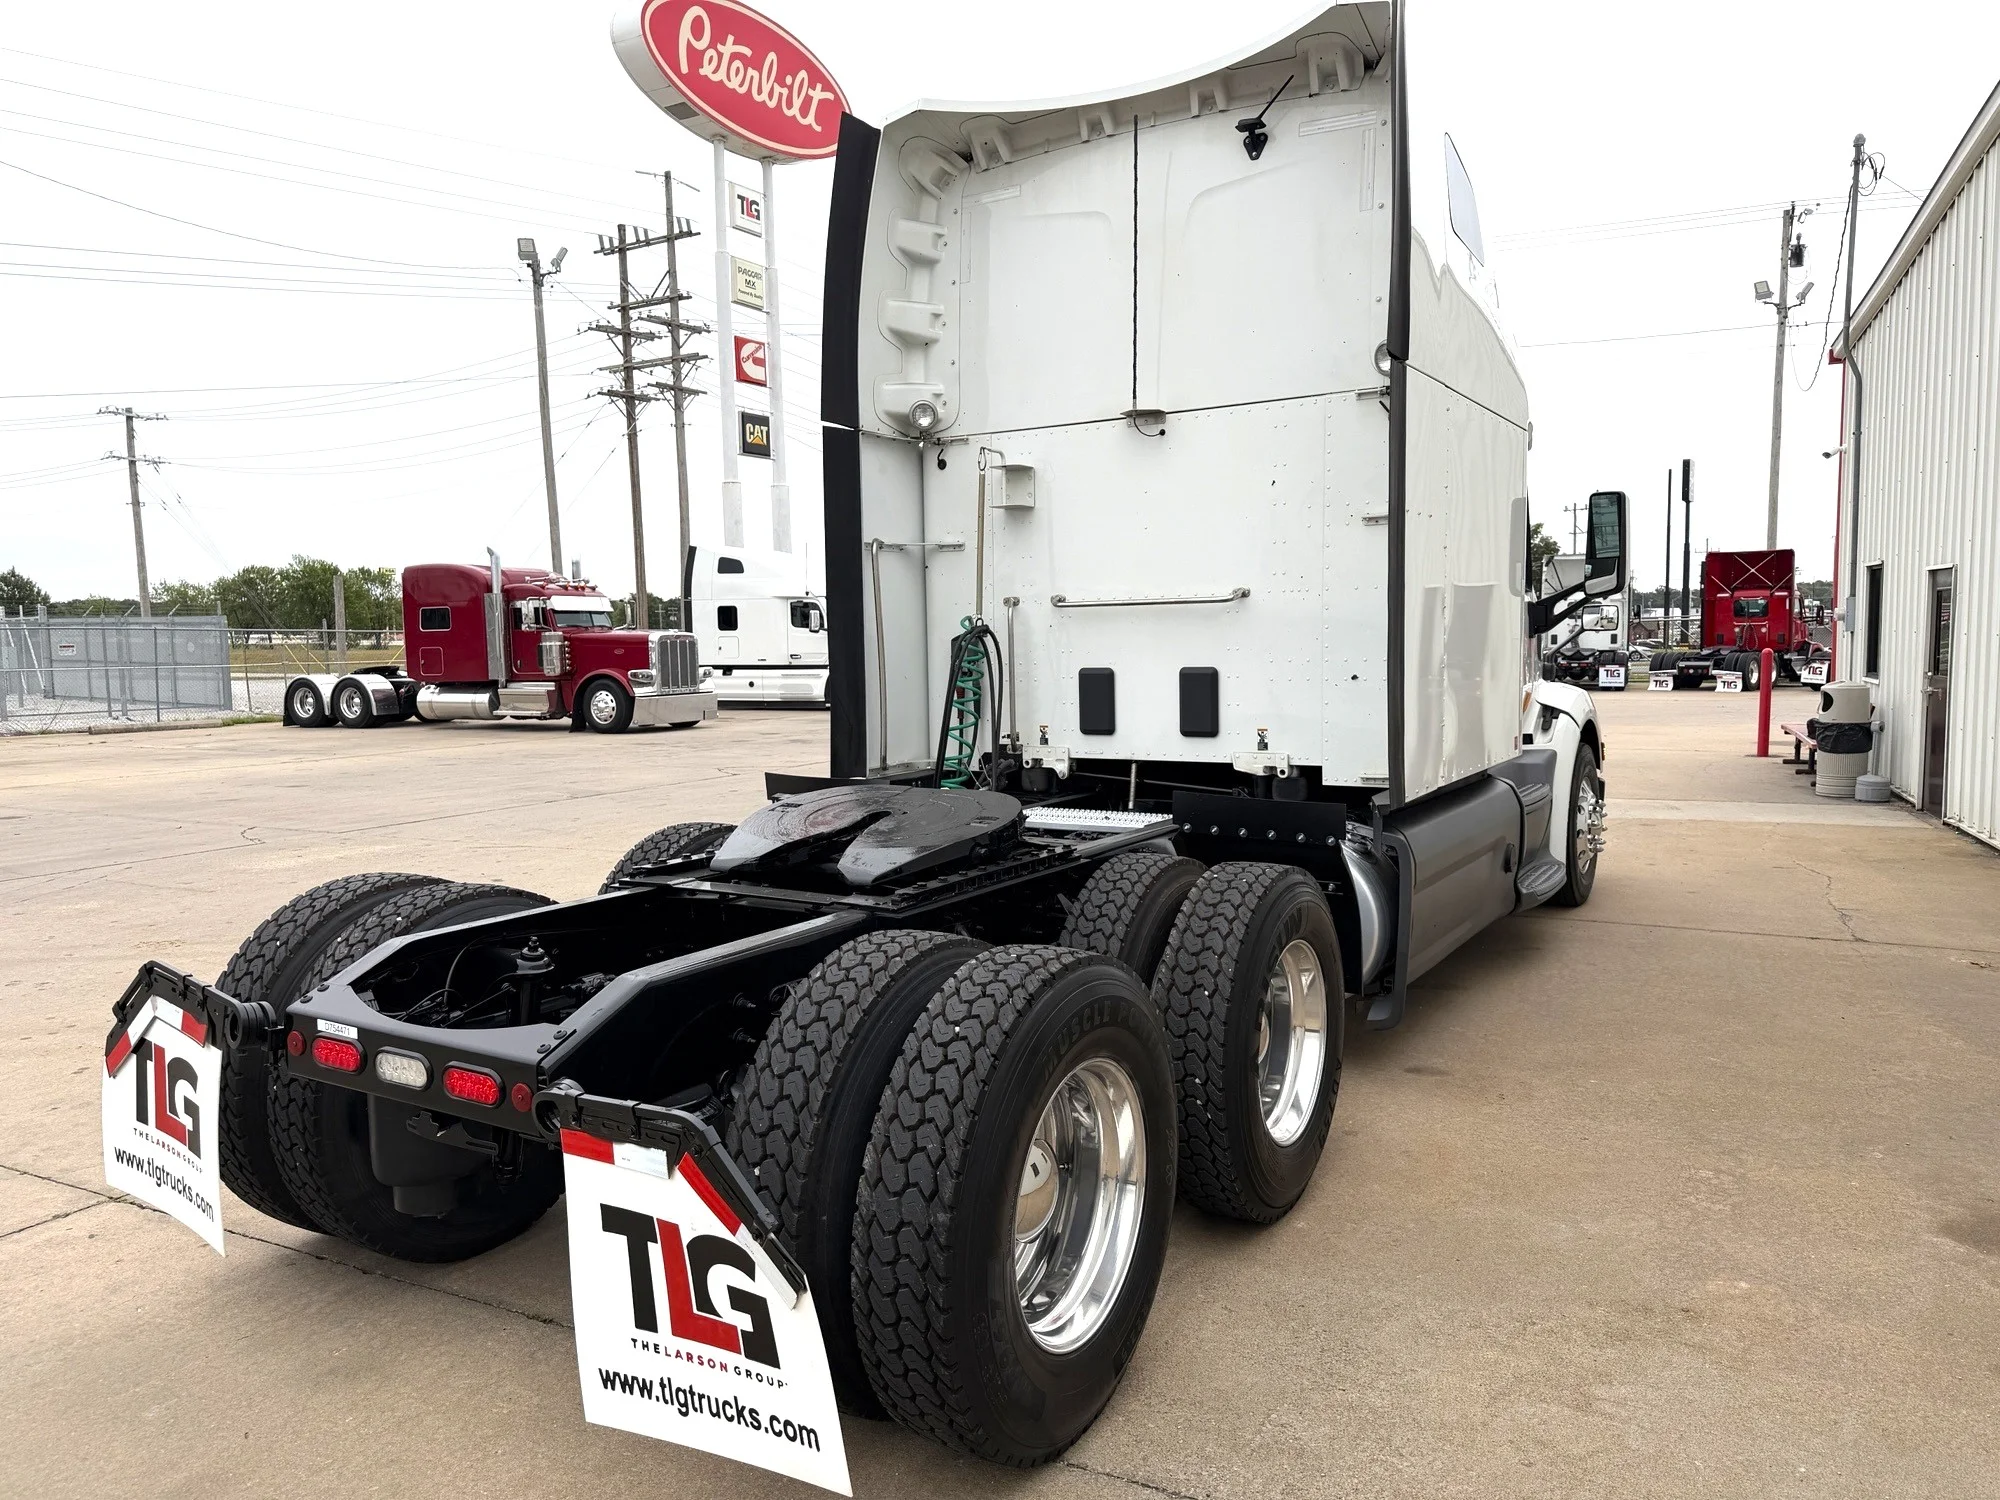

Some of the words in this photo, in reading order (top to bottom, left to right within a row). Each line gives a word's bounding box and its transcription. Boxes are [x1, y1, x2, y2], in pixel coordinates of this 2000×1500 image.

[678, 5, 835, 133] Peterbilt
[737, 194, 761, 221] TLG
[744, 278, 756, 288] MX
[742, 344, 763, 363] Cummins
[745, 423, 768, 445] CAT
[1604, 669, 1620, 678] TLG
[1808, 665, 1823, 675] TLG
[1653, 680, 1669, 688] TLG
[1720, 680, 1738, 689] TLG
[131, 1037, 202, 1160] TLG
[114, 1146, 215, 1223] www.tlgtrucks.com
[600, 1203, 781, 1370] TLG
[598, 1367, 821, 1452] www.tlgtrucks.com
